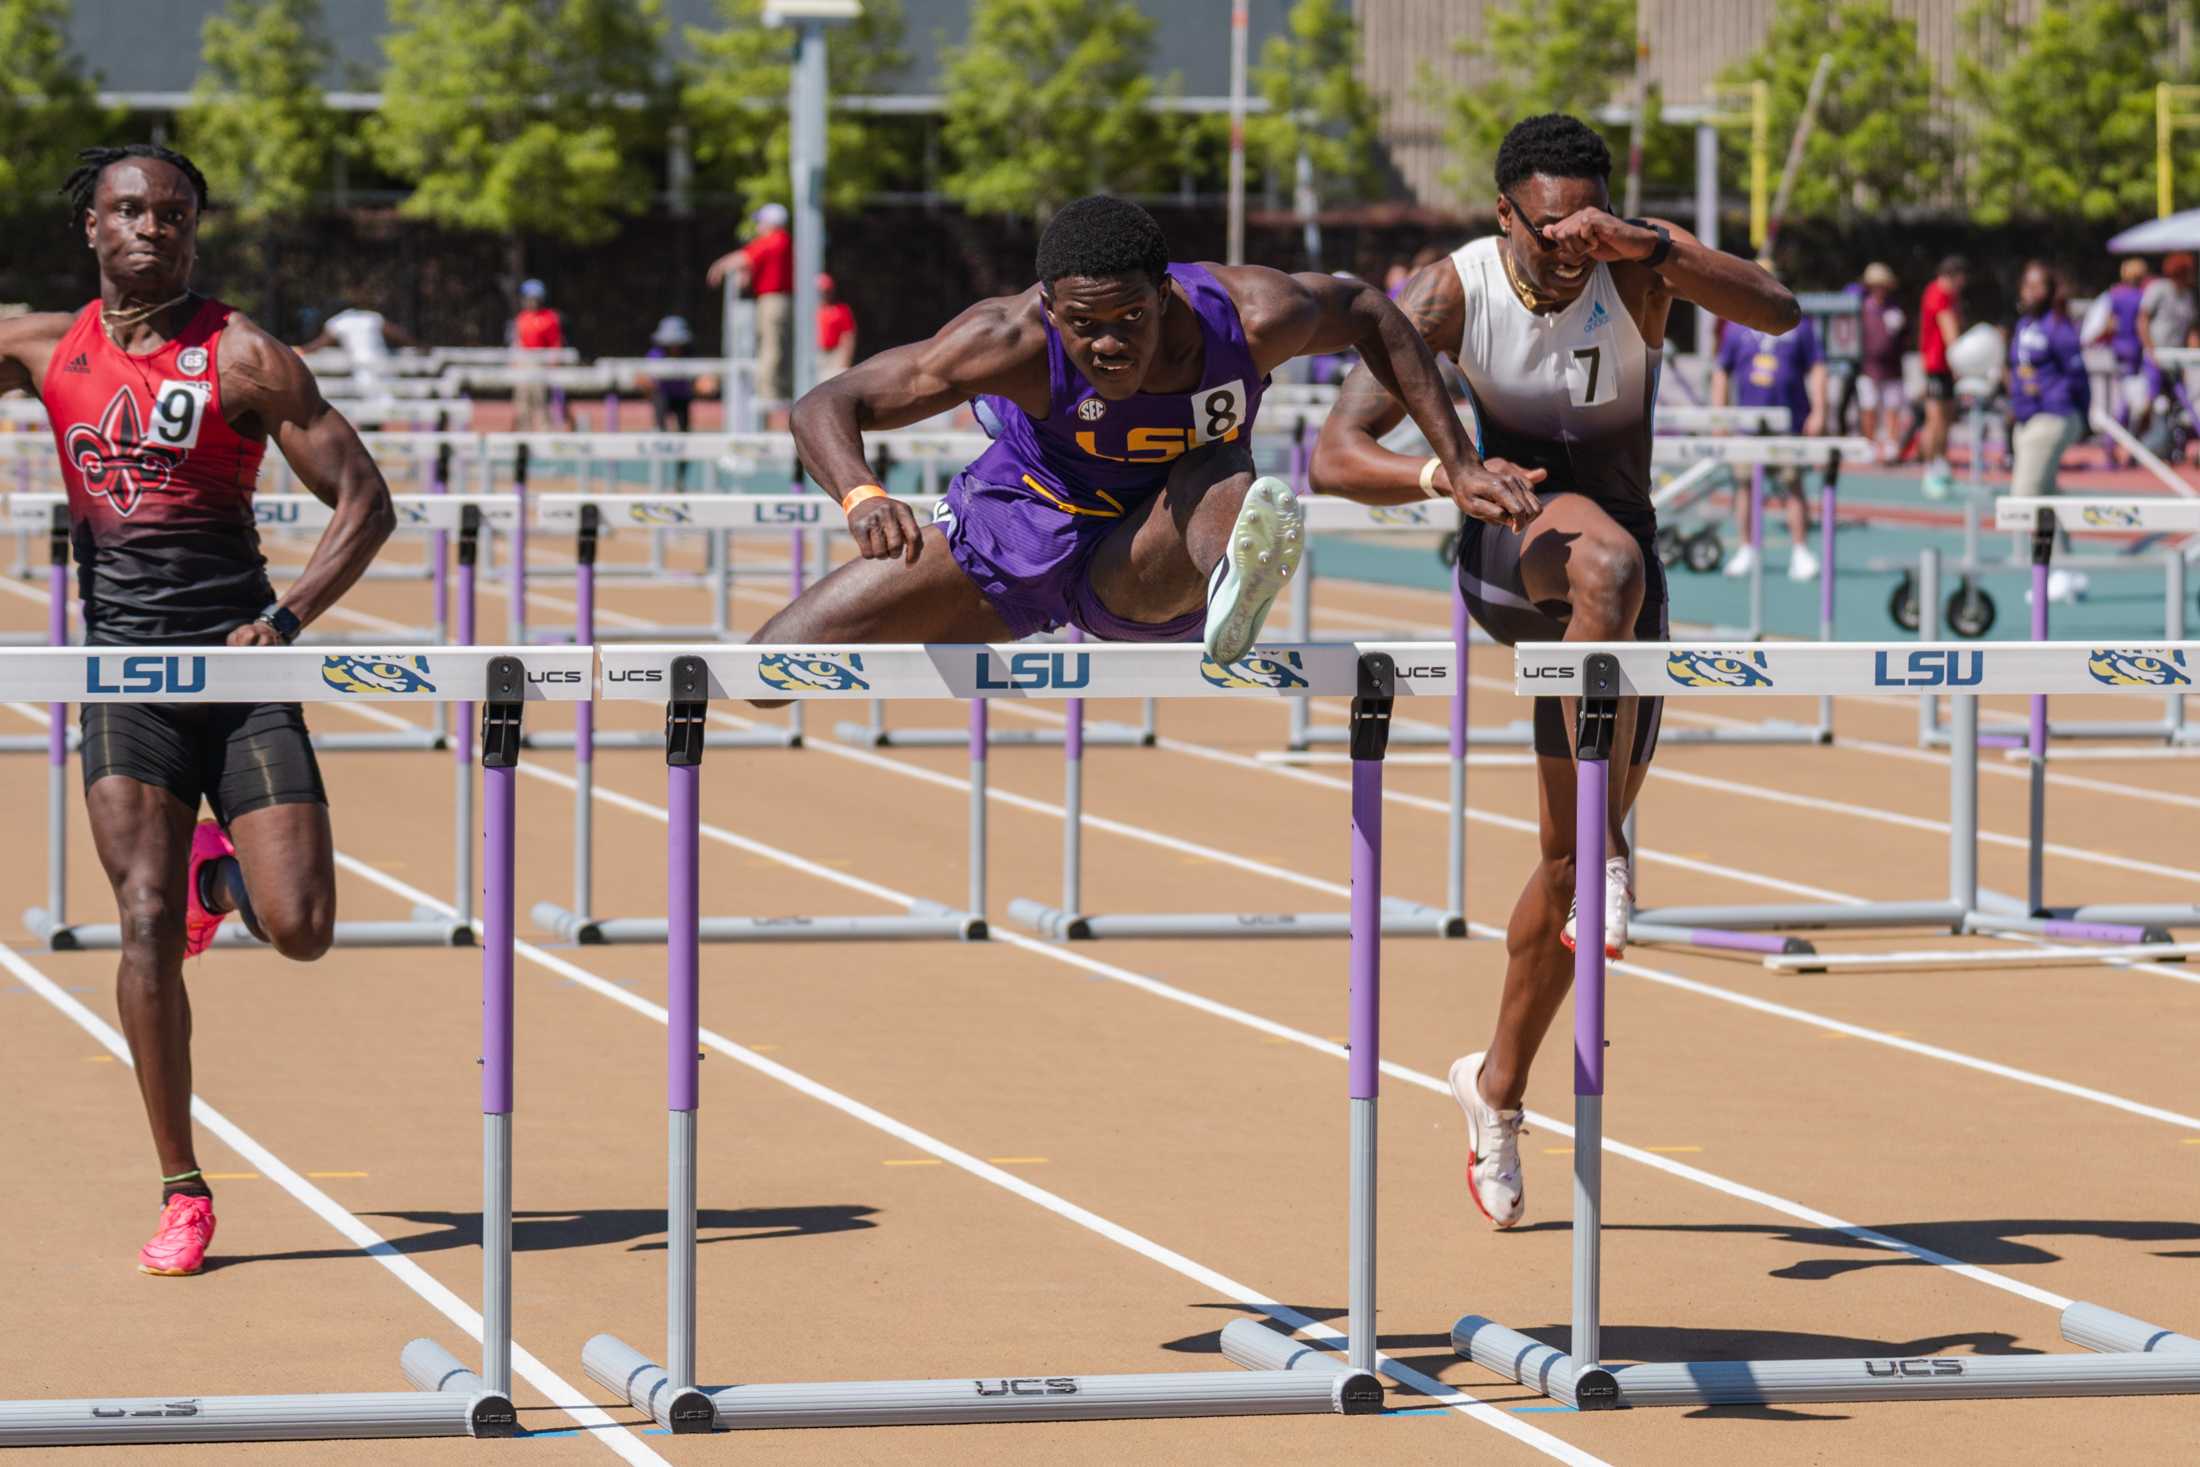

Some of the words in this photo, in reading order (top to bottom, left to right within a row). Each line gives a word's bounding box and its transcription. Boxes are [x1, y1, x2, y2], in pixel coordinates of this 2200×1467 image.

[1573, 346, 1600, 403] 7
[158, 389, 194, 442] 9
[1079, 401, 1105, 421] SEC
[1205, 390, 1238, 437] 8
[255, 502, 299, 524] SU
[755, 502, 820, 523] LSU
[87, 656, 206, 693] LSU
[527, 671, 582, 683] UCS
[608, 670, 663, 682] UCS
[976, 653, 1090, 689] LSU
[1395, 666, 1447, 678] UCS
[1523, 666, 1575, 678] UCS
[1875, 650, 1983, 686] LSU
[1865, 1359, 1964, 1378] UCS
[975, 1378, 1078, 1397] UCS
[476, 1414, 512, 1423] UCS
[674, 1410, 710, 1420] UCS
